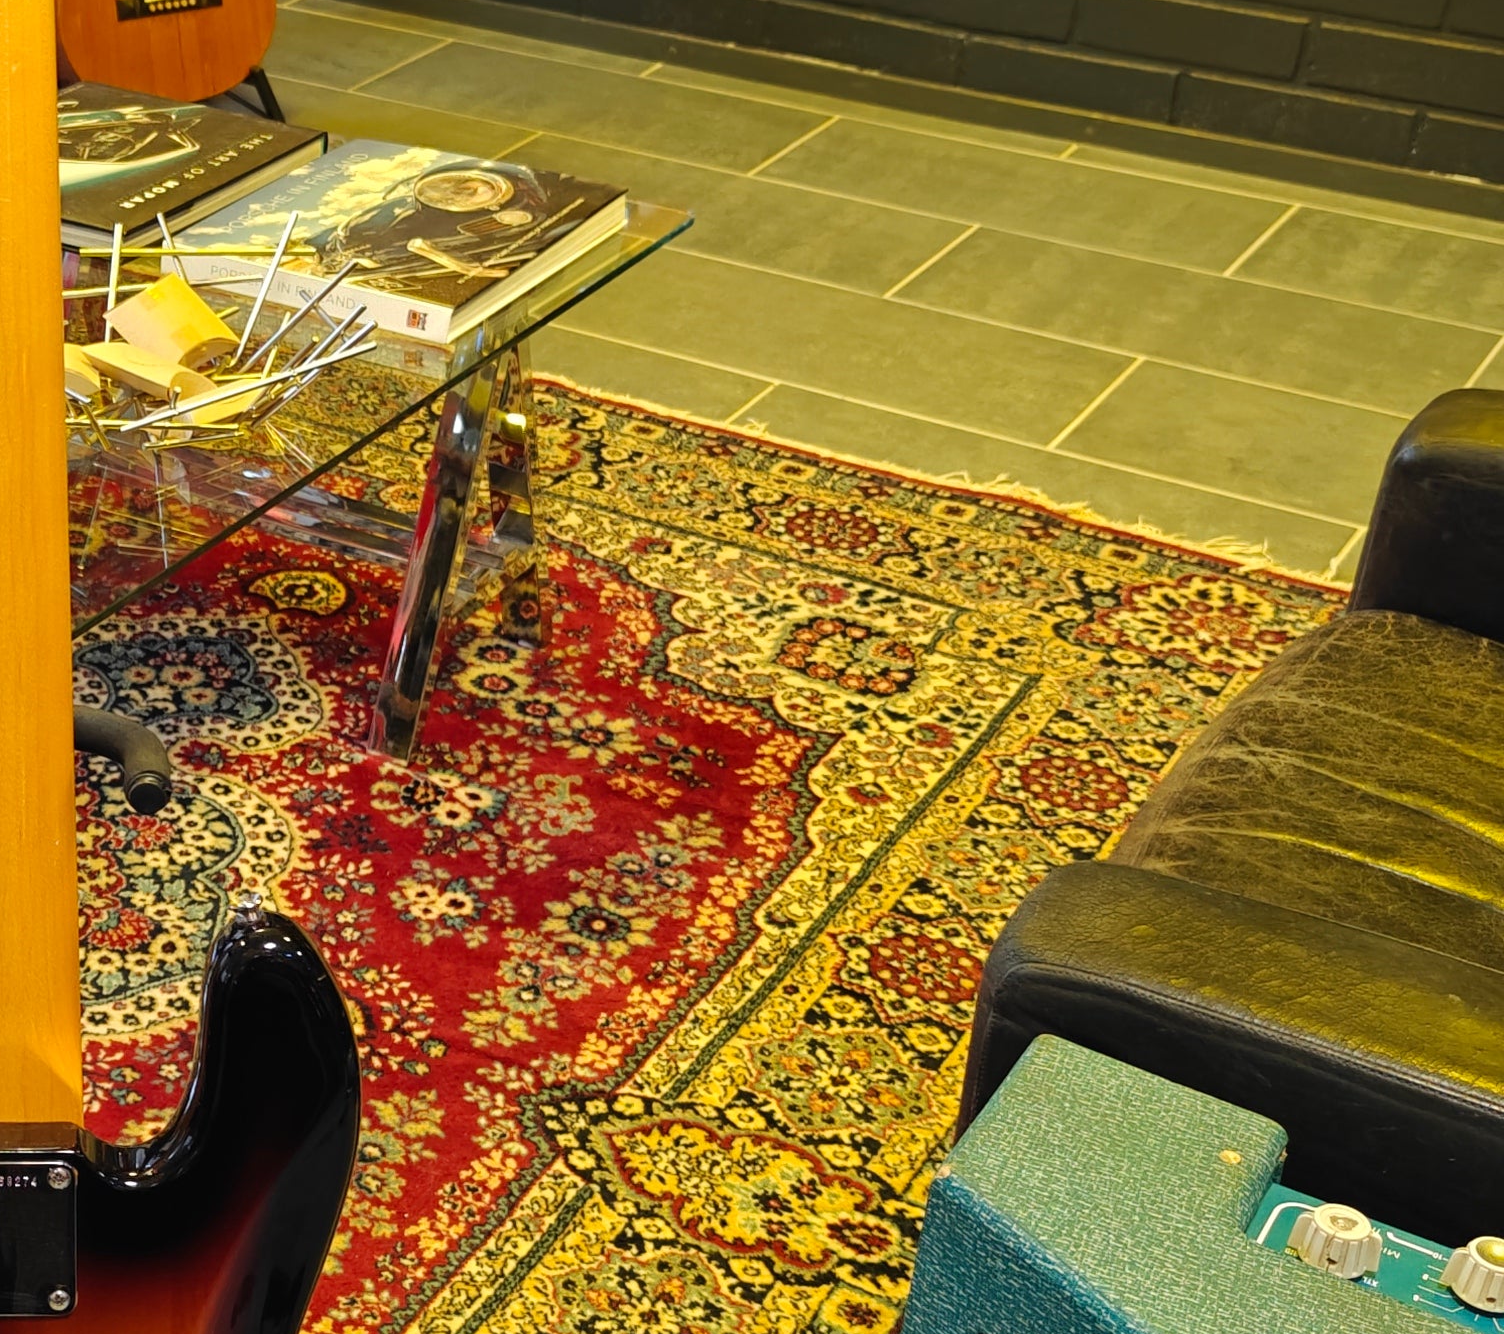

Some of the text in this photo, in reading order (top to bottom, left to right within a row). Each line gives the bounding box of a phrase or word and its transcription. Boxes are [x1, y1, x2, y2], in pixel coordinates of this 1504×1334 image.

[119, 133, 274, 210] THE ART OF MOPAR
[225, 152, 369, 234] PORSCHE IN FINLAND
[277, 281, 358, 310] IN FINAND
